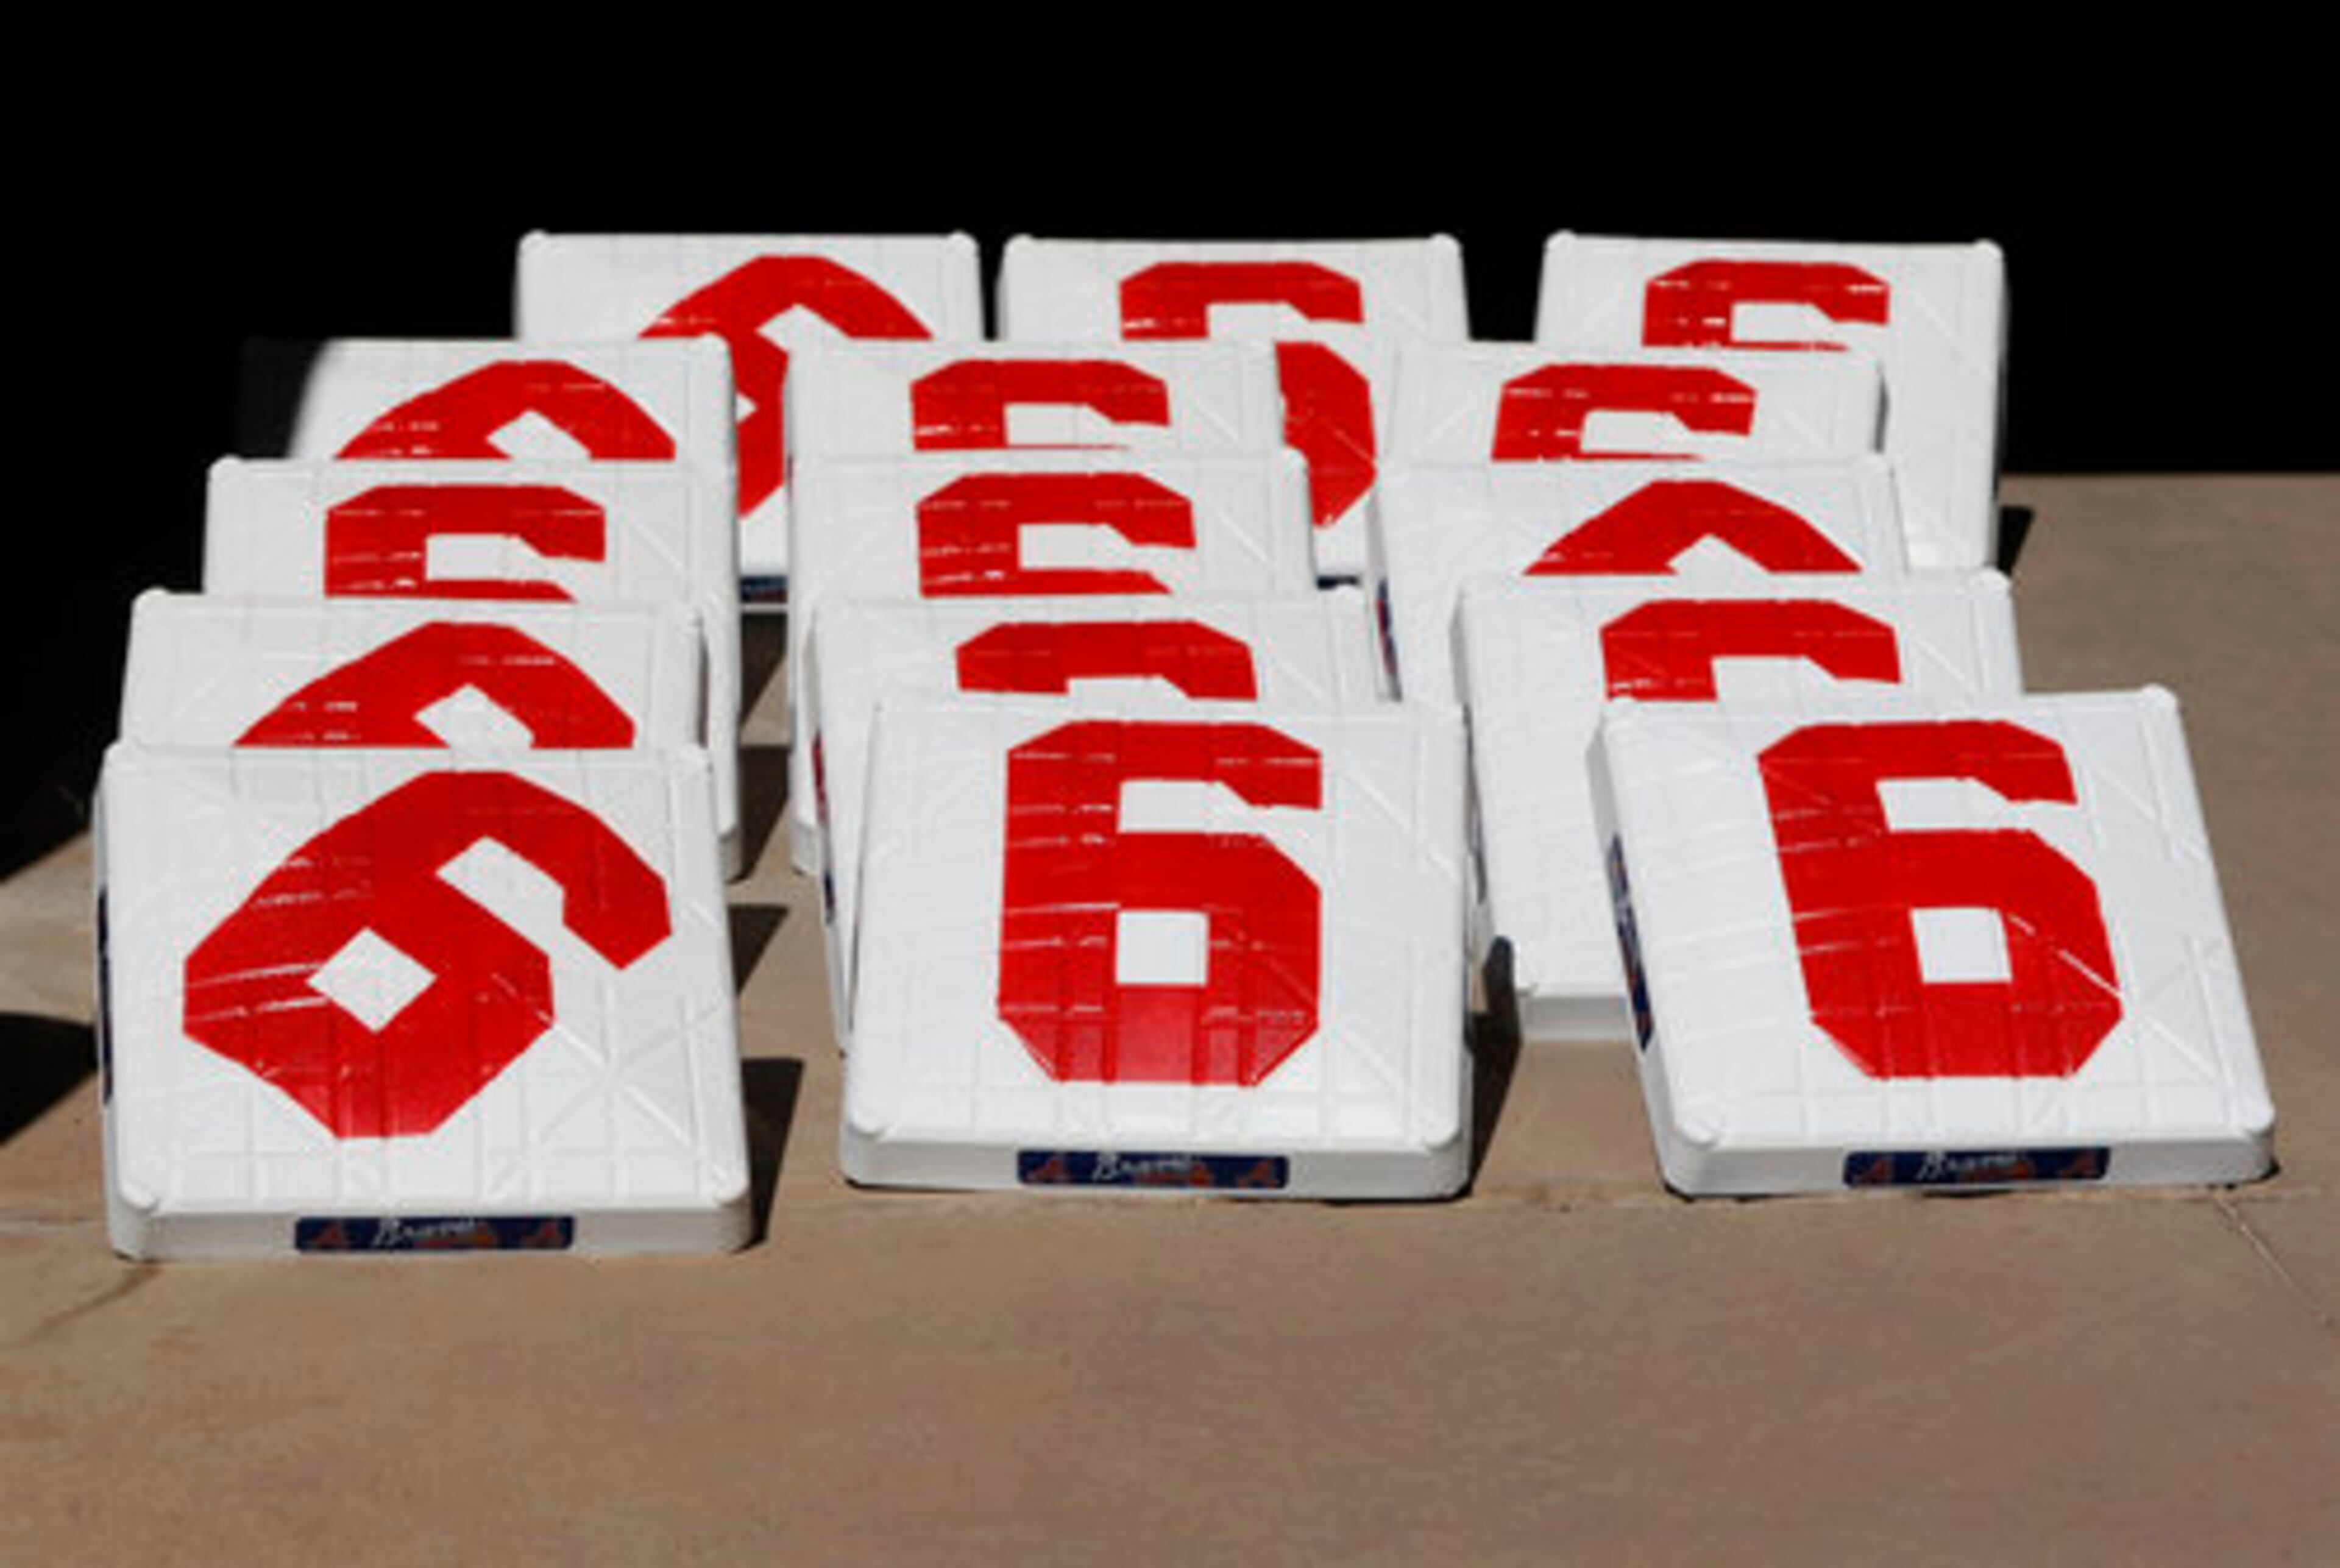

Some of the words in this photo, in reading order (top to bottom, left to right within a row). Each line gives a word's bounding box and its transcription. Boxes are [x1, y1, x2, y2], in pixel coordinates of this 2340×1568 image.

[183, 771, 672, 1138] 6
[998, 720, 1322, 1087] 6
[1758, 720, 2122, 1079] 6
